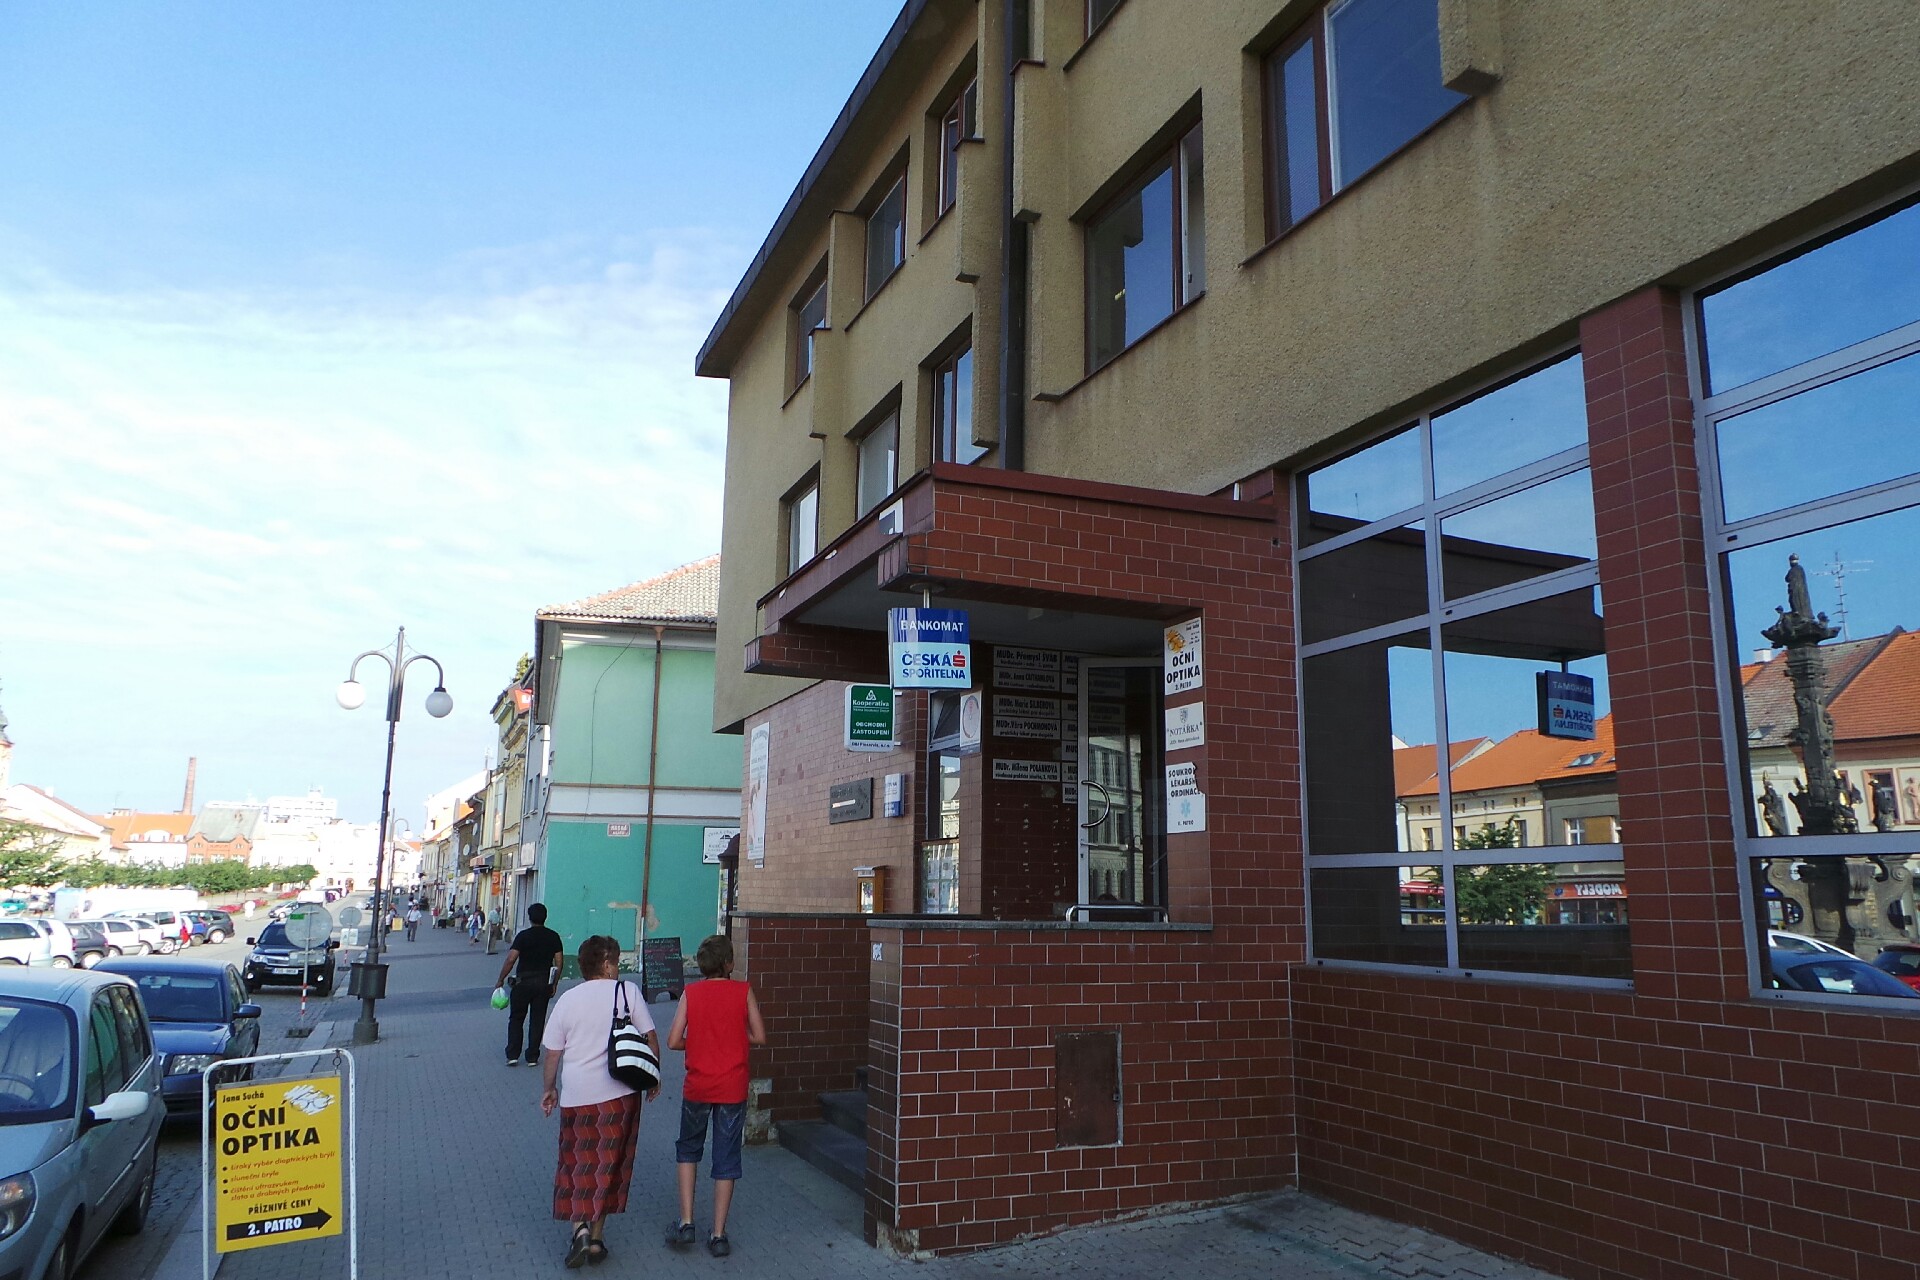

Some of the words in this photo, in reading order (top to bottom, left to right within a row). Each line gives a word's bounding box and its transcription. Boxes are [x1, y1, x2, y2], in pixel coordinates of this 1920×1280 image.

[901, 620, 964, 632] BANKOMAT
[902, 651, 952, 666] ČESKÁ
[997, 649, 1014, 659] MUDr.
[1173, 648, 1194, 667] OČNÍ
[902, 667, 966, 679] SPOŘITELNA
[1166, 665, 1200, 684] OPTIKA
[1180, 681, 1191, 689] PATRO
[223, 1094, 240, 1103] Jana
[242, 1091, 265, 1101] Suchá
[222, 1100, 287, 1131] OČNÍ
[222, 1127, 320, 1156] OPTIKA
[248, 1200, 288, 1215] PŘÍZNIVÉ
[290, 1198, 312, 1208] CENY
[248, 1223, 261, 1236] 2.
[264, 1216, 302, 1233] PATRO
